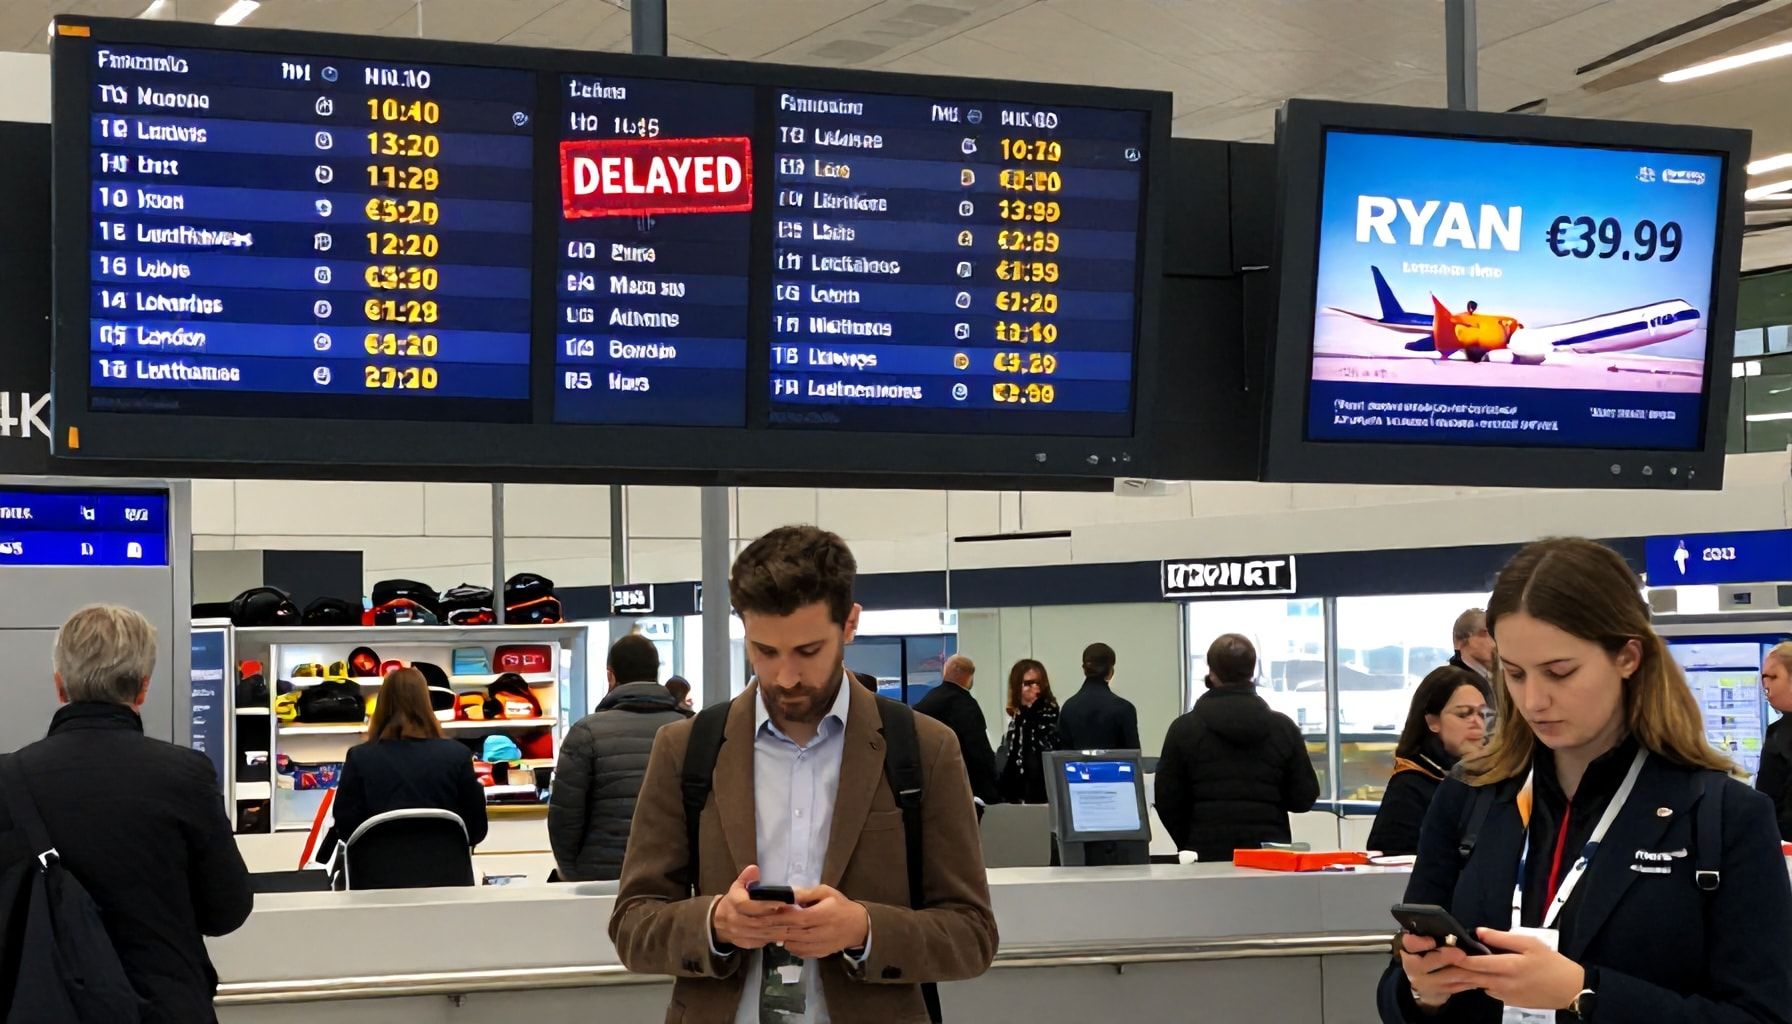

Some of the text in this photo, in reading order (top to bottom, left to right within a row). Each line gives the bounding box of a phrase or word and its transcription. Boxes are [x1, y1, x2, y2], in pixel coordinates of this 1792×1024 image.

[367, 131, 440, 158] 13:20
[573, 156, 742, 195] DELAYED
[1356, 195, 1683, 263] RYAN €39.99
[366, 231, 439, 258] 12:20
[100, 255, 127, 276] 16
